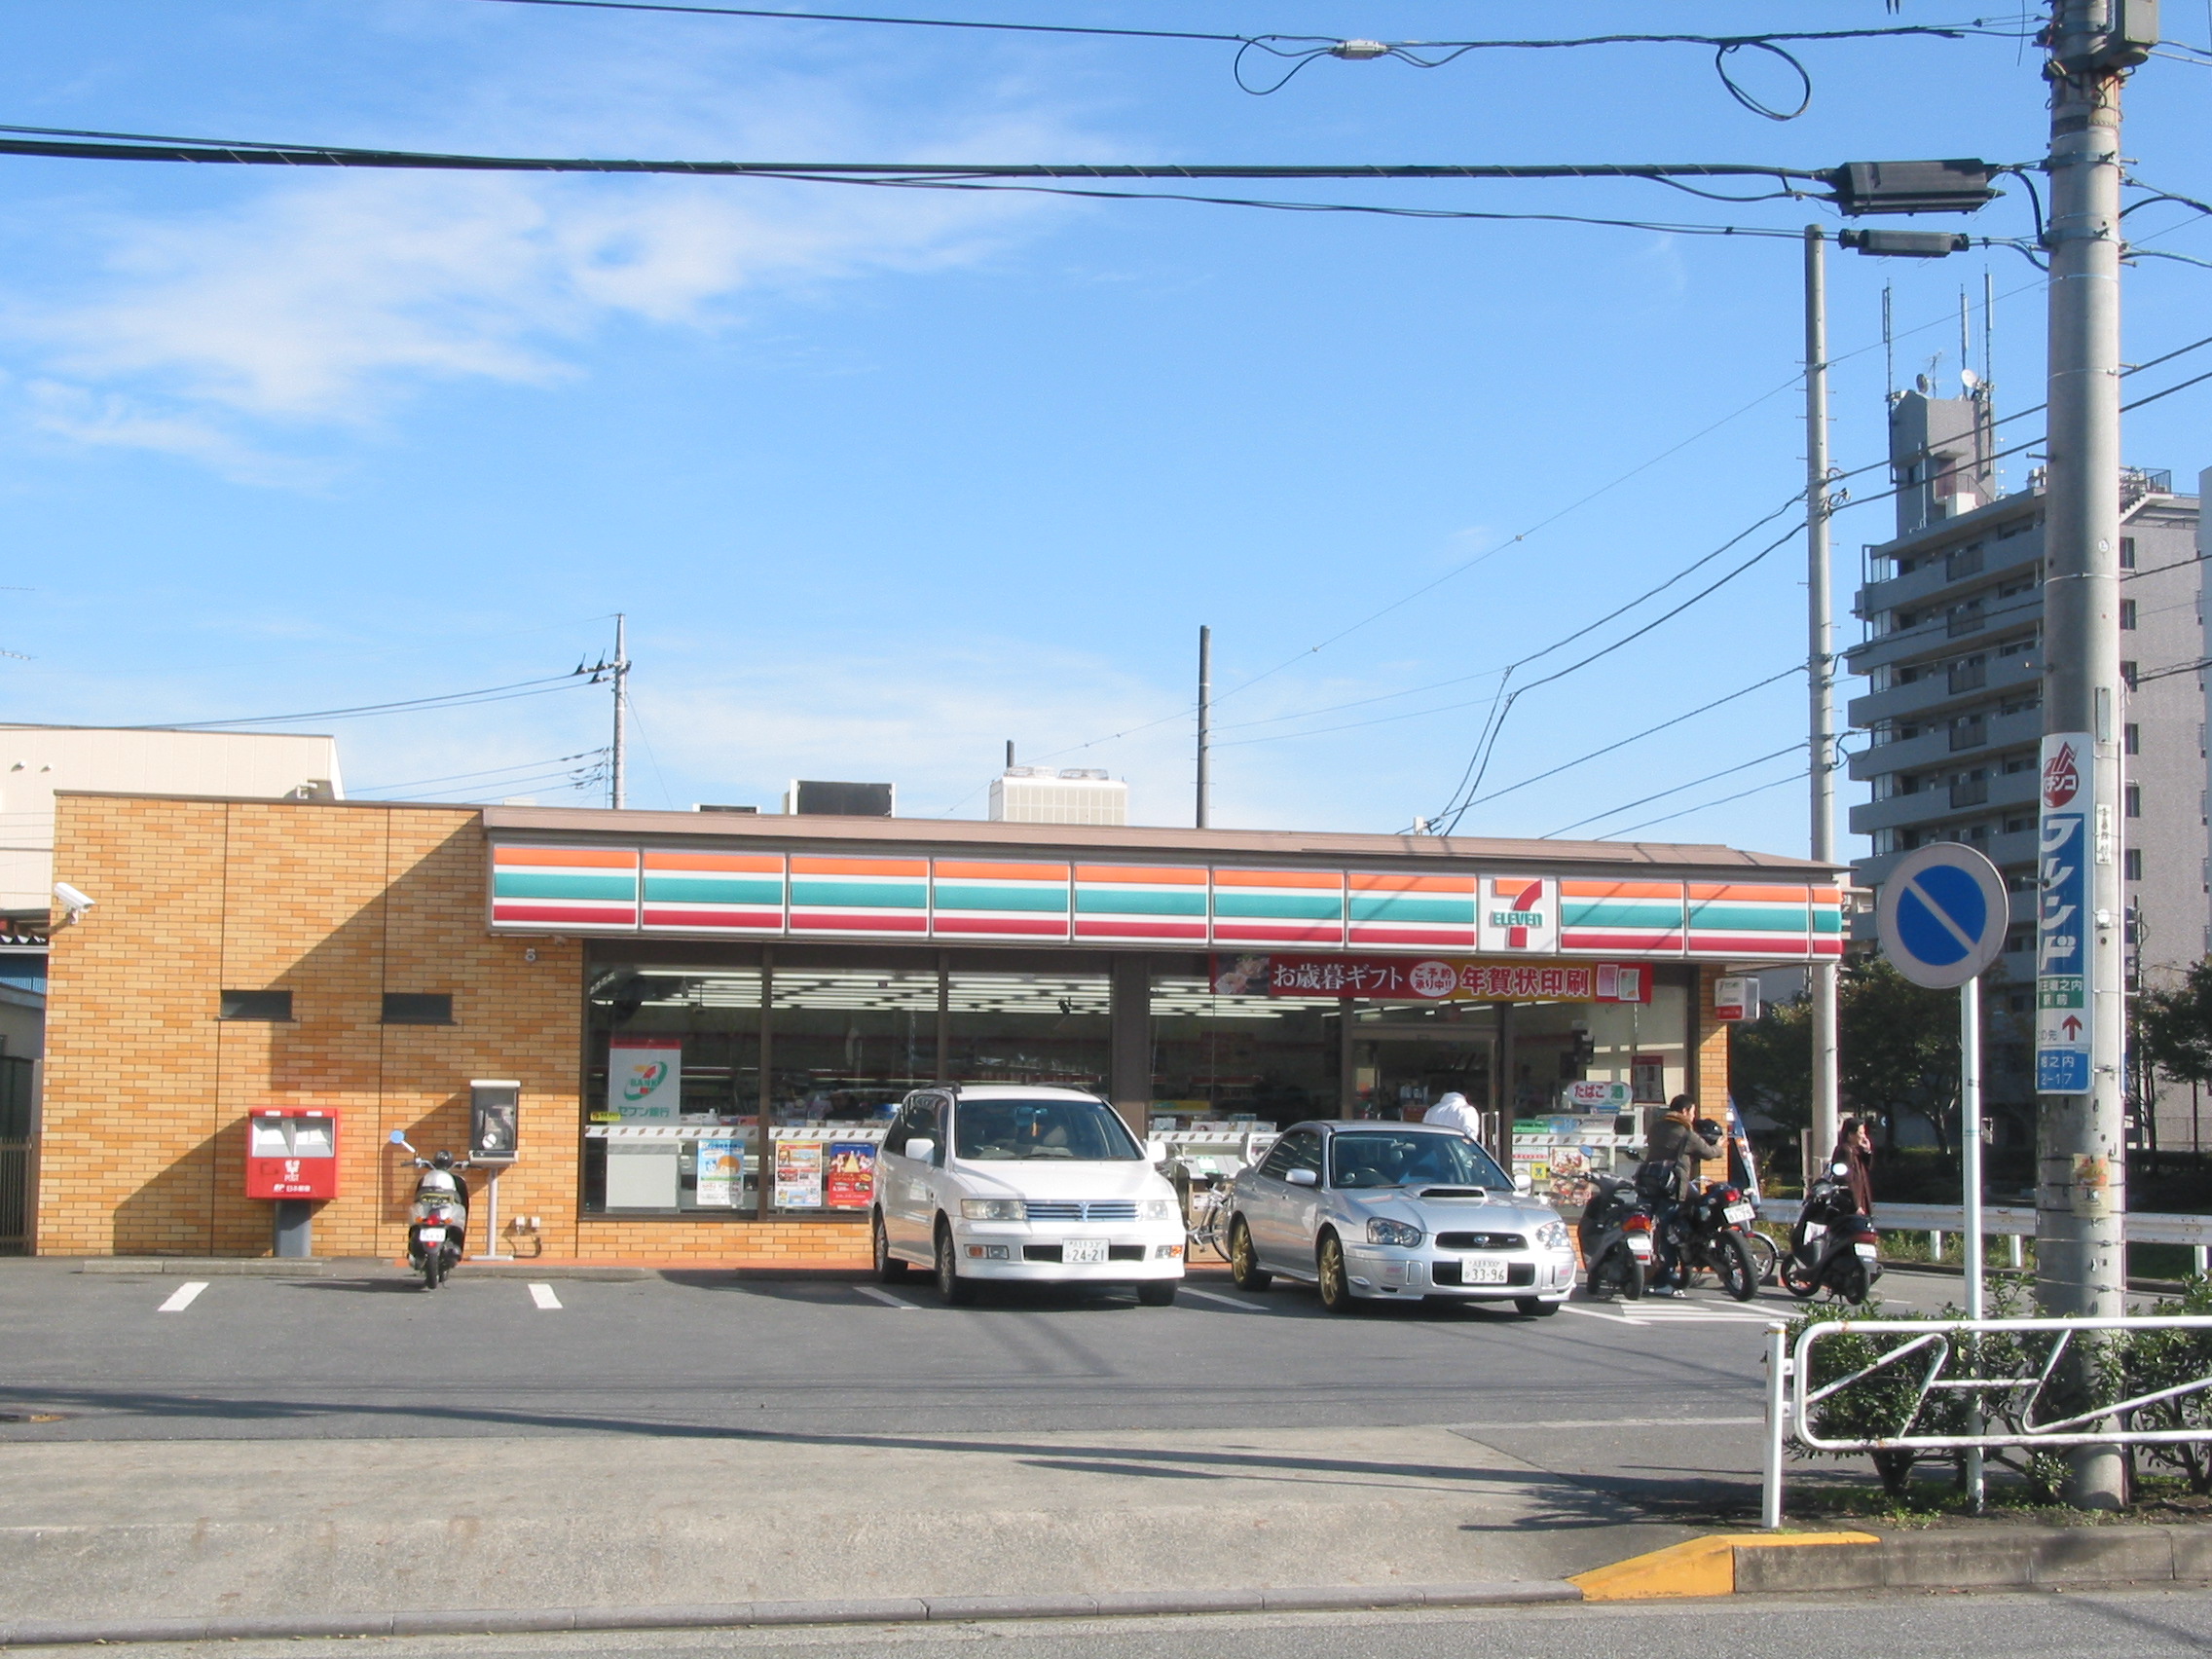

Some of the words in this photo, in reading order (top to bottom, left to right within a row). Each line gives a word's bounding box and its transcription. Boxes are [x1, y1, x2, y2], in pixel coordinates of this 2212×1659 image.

[2041, 818, 2083, 972] フレンド
[1272, 963, 1403, 990] お歳暮ギフト
[1460, 964, 1592, 997] 年賀状印刷
[2041, 1073, 2073, 1087] 2-17
[1573, 1085, 1605, 1098] たばこ
[1072, 1248, 1104, 1262] 24-21
[1471, 1268, 1505, 1281] 33-96
